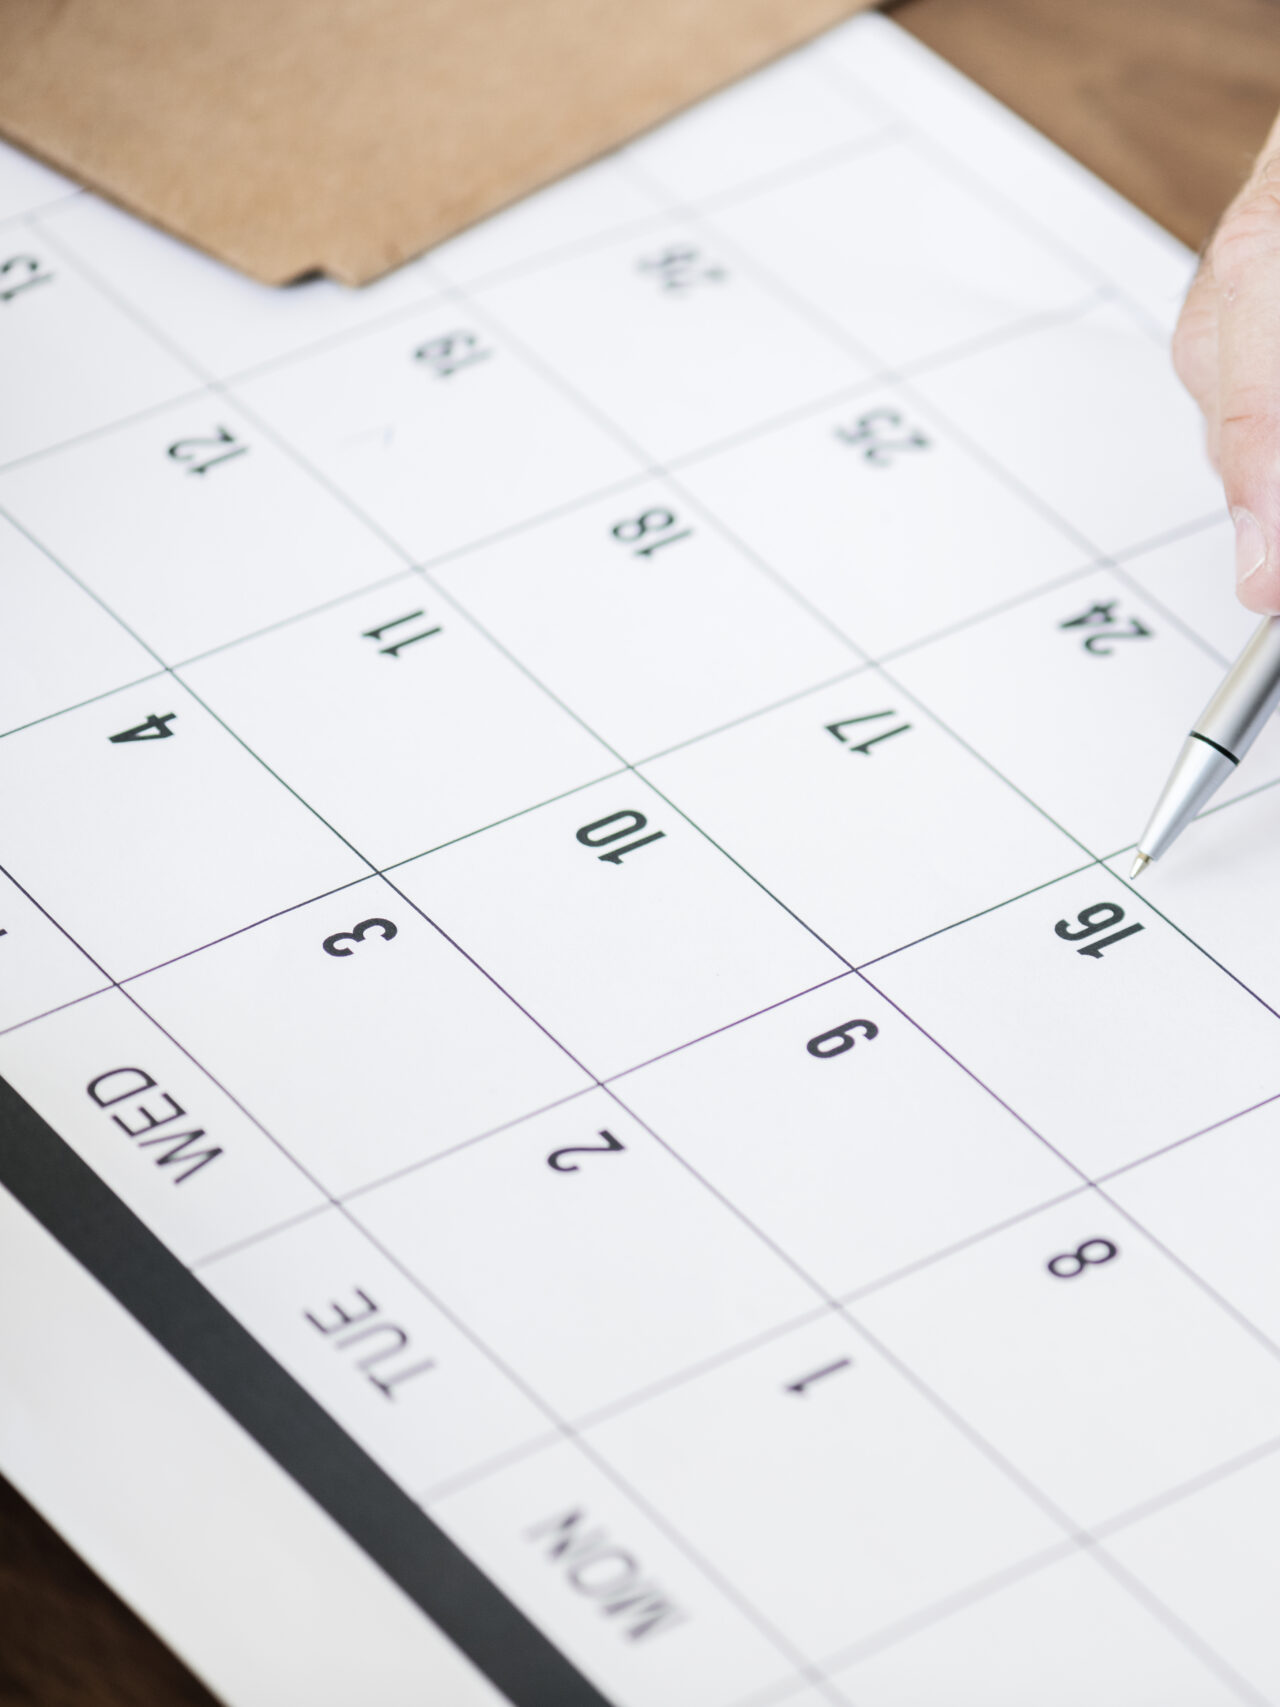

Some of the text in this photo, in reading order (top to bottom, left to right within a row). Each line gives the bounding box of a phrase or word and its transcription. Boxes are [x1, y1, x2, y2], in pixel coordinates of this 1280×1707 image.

[411, 328, 491, 381] 19
[167, 423, 249, 477] 12
[835, 406, 931, 467] 25
[612, 510, 689, 557] 18
[363, 611, 441, 657] 11
[1060, 602, 1152, 655] 24
[108, 712, 176, 743] 4
[825, 710, 911, 755] 17
[576, 810, 666, 865] 10
[323, 918, 397, 957] 3
[1055, 902, 1145, 959] 16
[807, 1019, 879, 1058] 9
[87, 1067, 223, 1184] WED
[547, 1130, 625, 1173] 2
[1047, 1238, 1118, 1279] 8
[304, 1287, 438, 1401] TUE
[782, 1356, 853, 1398] 1
[525, 1505, 692, 1644] MON
